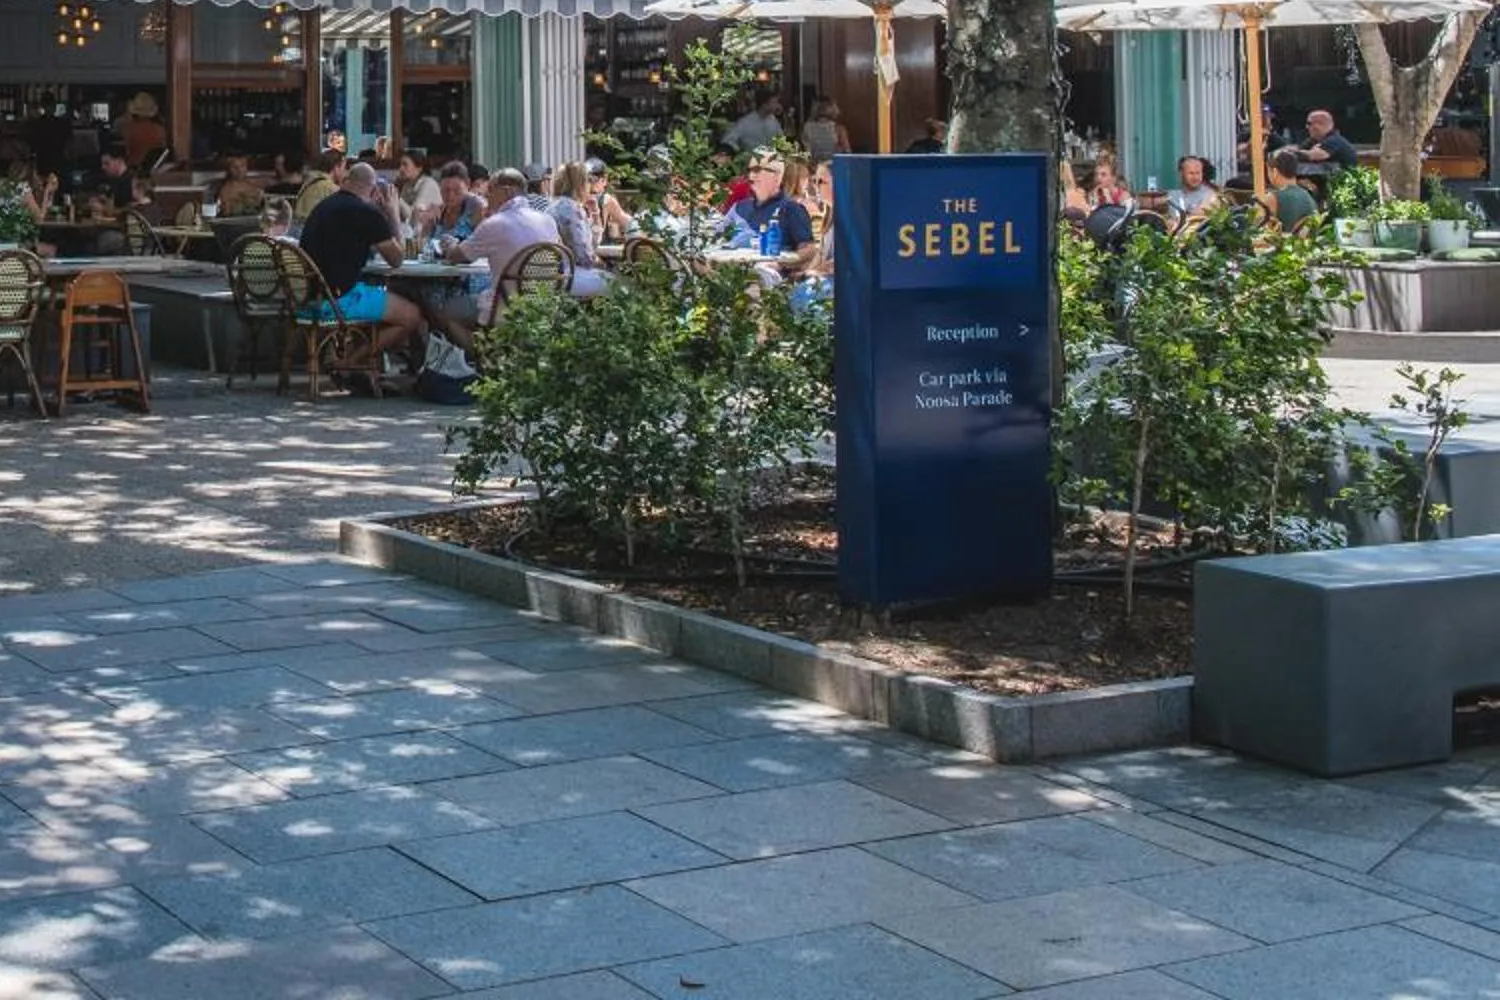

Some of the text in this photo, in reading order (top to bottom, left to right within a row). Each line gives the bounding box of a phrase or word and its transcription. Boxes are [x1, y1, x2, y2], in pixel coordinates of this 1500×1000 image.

[942, 198, 978, 214] THE
[897, 220, 1022, 257] SEBEL
[926, 323, 999, 344] Reception
[919, 367, 1007, 389] Car park via
[915, 390, 1013, 409] Noosa Parade
